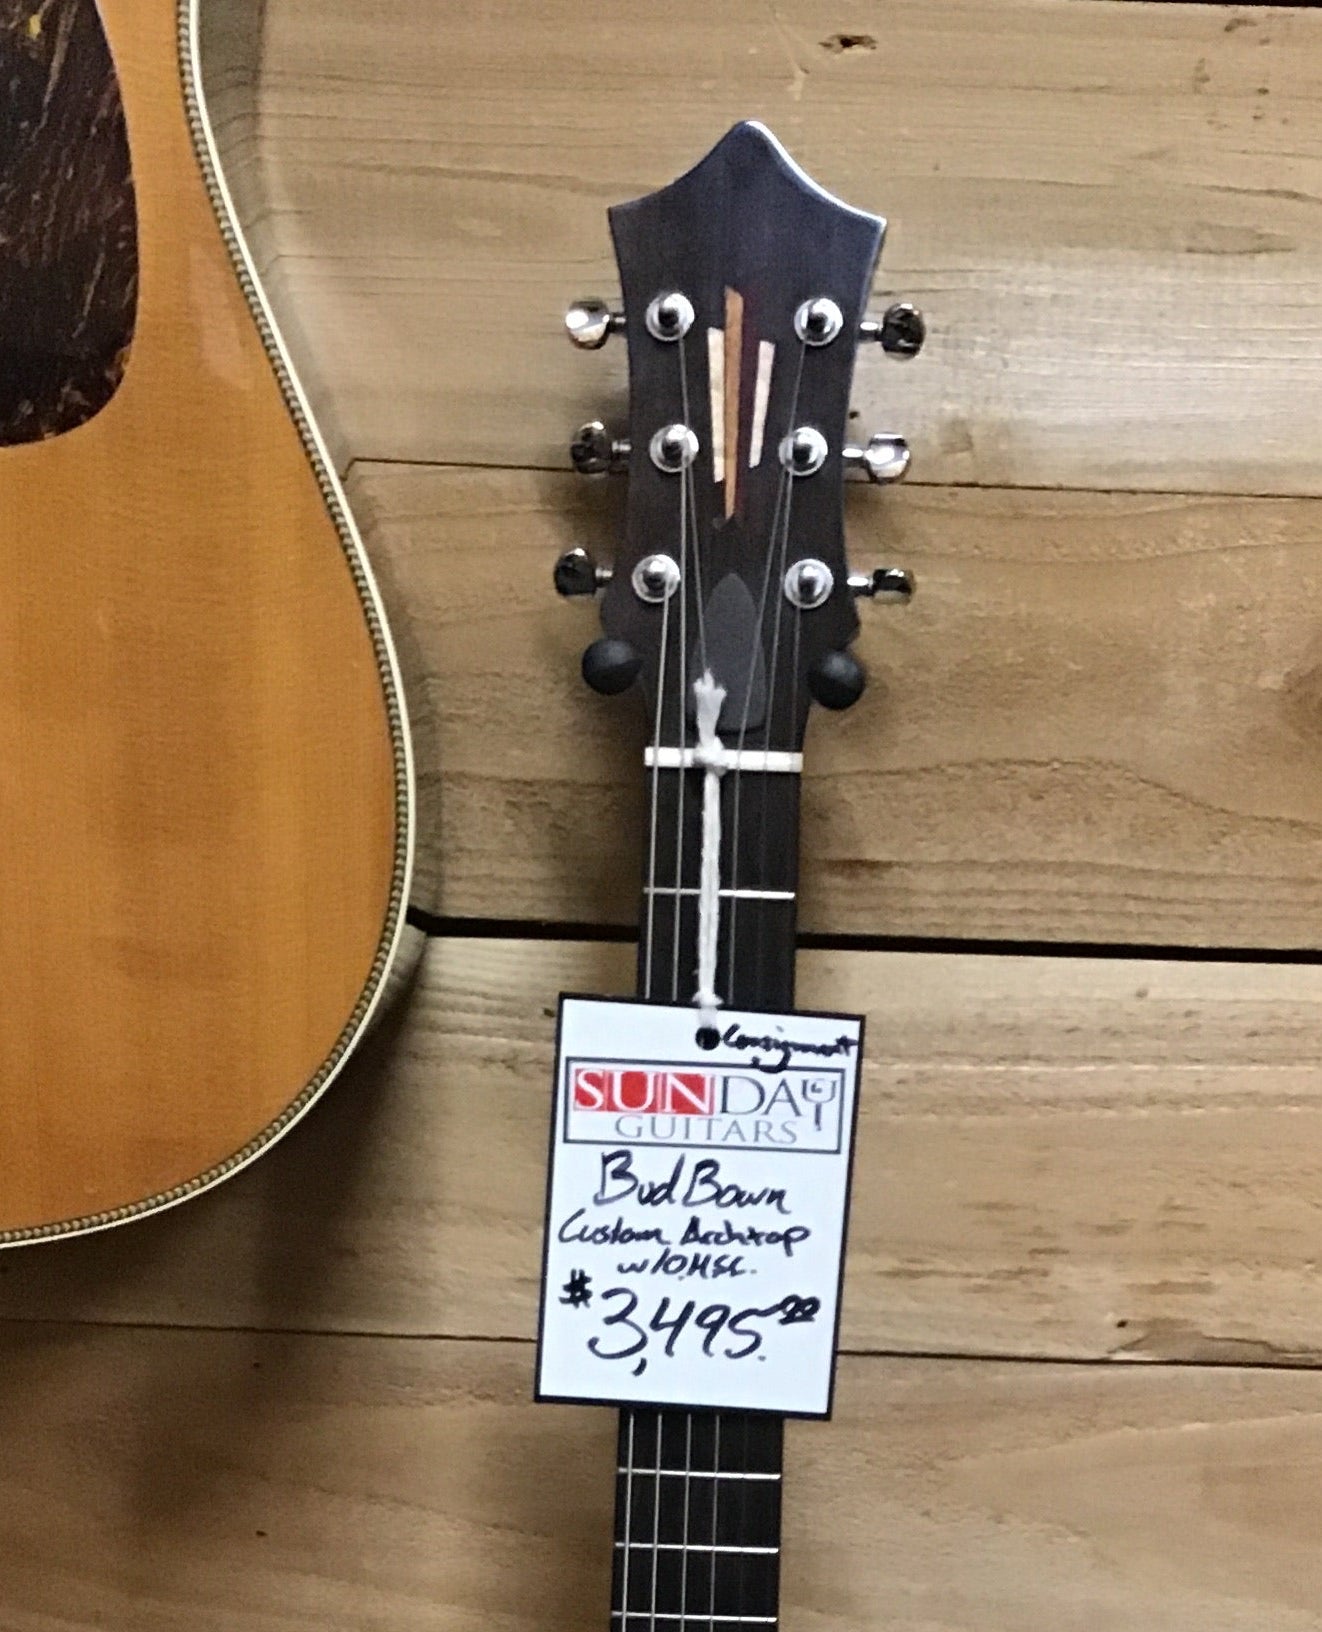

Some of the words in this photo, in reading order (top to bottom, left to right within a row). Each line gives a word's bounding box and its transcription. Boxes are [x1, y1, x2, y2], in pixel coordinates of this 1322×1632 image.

[722, 1023, 858, 1074] Consignment
[574, 1068, 837, 1131] SUNDAY
[614, 1115, 798, 1145] GUITARS
[593, 1149, 685, 1207] Bud
[557, 1207, 672, 1246] Custom
[679, 1215, 812, 1258] Archtop
